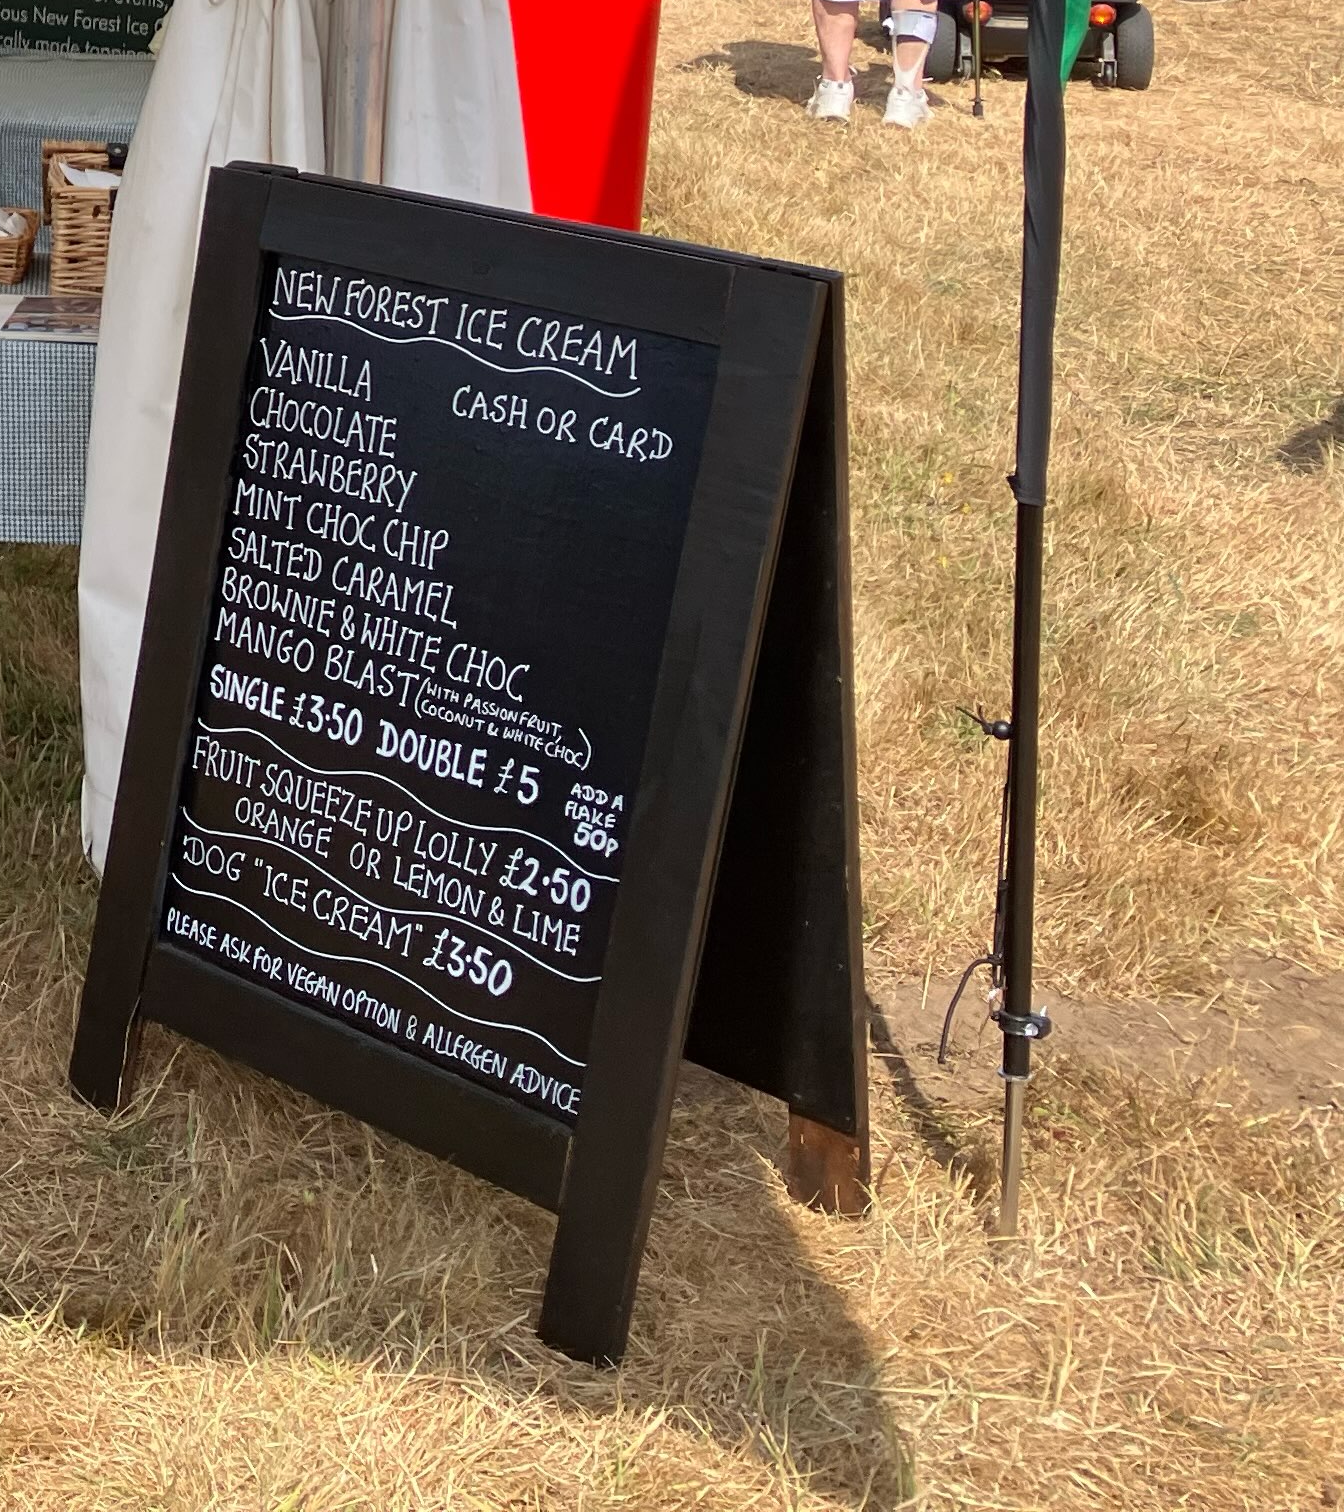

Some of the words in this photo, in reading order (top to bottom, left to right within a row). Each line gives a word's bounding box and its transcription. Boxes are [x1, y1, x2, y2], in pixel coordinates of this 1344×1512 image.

[32, 4, 69, 27] New
[73, 9, 123, 34] Forest
[126, 17, 150, 37] Ice
[35, 36, 81, 54] made
[272, 267, 342, 315] NEW
[344, 278, 449, 335] FOREST
[455, 303, 508, 350] ICE
[516, 316, 639, 381] CREAM
[259, 337, 372, 402] VANILLA
[249, 386, 398, 459] CHOCOLATE
[452, 384, 529, 430] CASH
[536, 406, 577, 443] OR
[588, 416, 674, 463] CARD
[243, 433, 418, 513] STRAWBERRY
[232, 478, 303, 530] MINT
[306, 501, 377, 552] CHOC
[383, 518, 450, 571] CHIP
[228, 527, 323, 581] SALTED
[332, 555, 458, 630] CARAMEL
[214, 606, 315, 673] MANGO
[324, 644, 420, 707] BLAST
[221, 566, 336, 638] BROWNIE
[340, 604, 356, 640] &
[360, 612, 442, 673] WHITE
[446, 643, 531, 702] CHOC
[210, 663, 286, 721] SINGLE
[376, 719, 488, 788] DOUBLE
[494, 757, 541, 805] £5
[421, 698, 486, 730] COCONUT
[487, 723, 499, 737] &
[503, 727, 544, 751] WHITE
[192, 735, 261, 779] FRUIT
[260, 763, 372, 837] SQUEEZE
[376, 805, 413, 847] UP
[413, 819, 499, 876] LOLLY
[564, 800, 617, 829] FLAKE
[570, 782, 609, 806] ADD
[610, 793, 625, 812] A
[182, 834, 247, 882] DOG
[234, 796, 334, 859] ORANGE
[349, 842, 382, 880] OR
[392, 855, 487, 920] LEMON
[488, 894, 506, 928] &
[511, 903, 582, 957] LIME
[166, 906, 217, 949] PLEASE
[219, 931, 250, 964] ASK
[252, 947, 284, 982] FOR
[286, 961, 340, 1009] VEGAN
[342, 986, 402, 1035] OPTION
[404, 1014, 419, 1040] &
[421, 1022, 509, 1080] ALLERGEN
[509, 1061, 583, 1117] ADVICE
